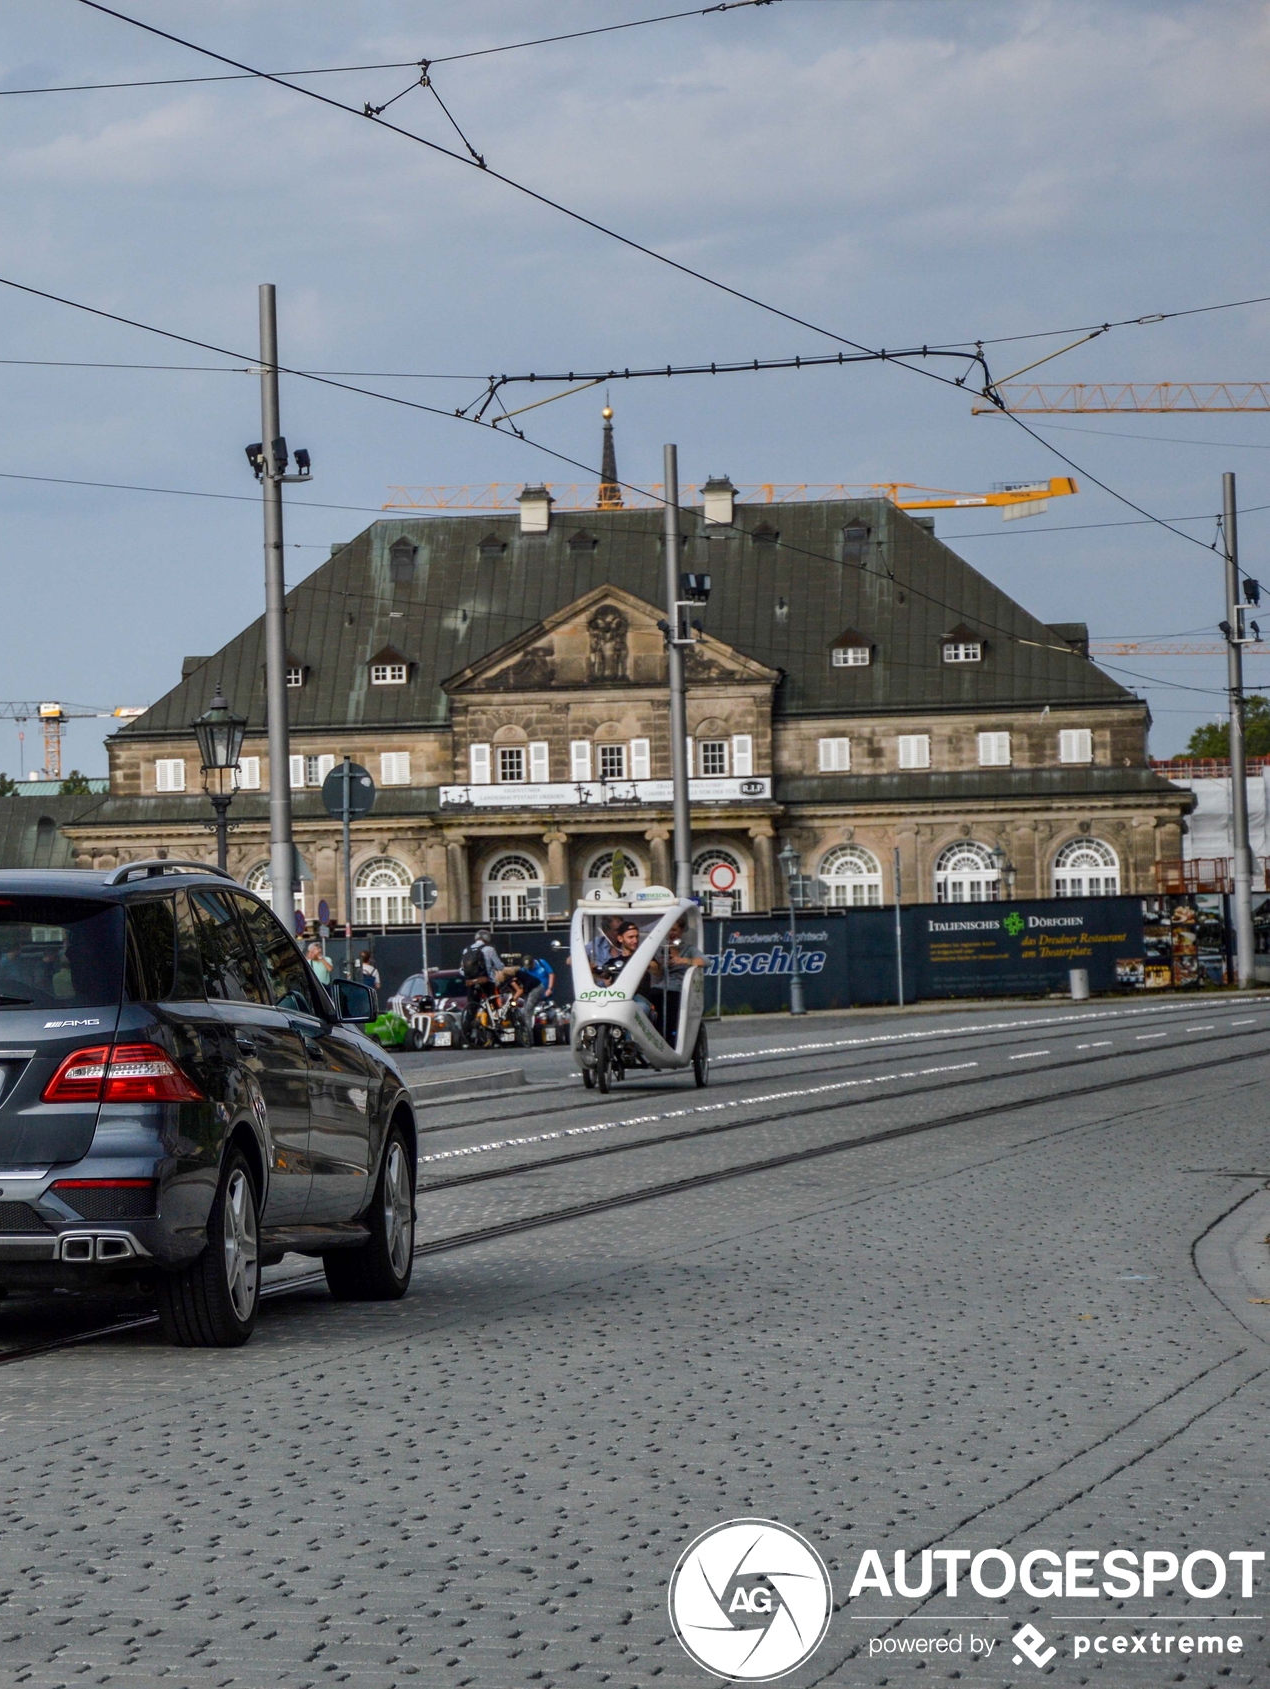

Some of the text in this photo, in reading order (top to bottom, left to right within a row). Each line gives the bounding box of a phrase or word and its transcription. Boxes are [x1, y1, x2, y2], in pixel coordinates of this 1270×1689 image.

[742, 784, 764, 793] R.I.P.
[594, 890, 601, 901] 6
[1021, 932, 1127, 947] das Dresdner Restaurant
[1022, 950, 1037, 959] am
[704, 945, 827, 976] ntschke
[579, 990, 626, 1001] apriva
[61, 1018, 100, 1027] AMG
